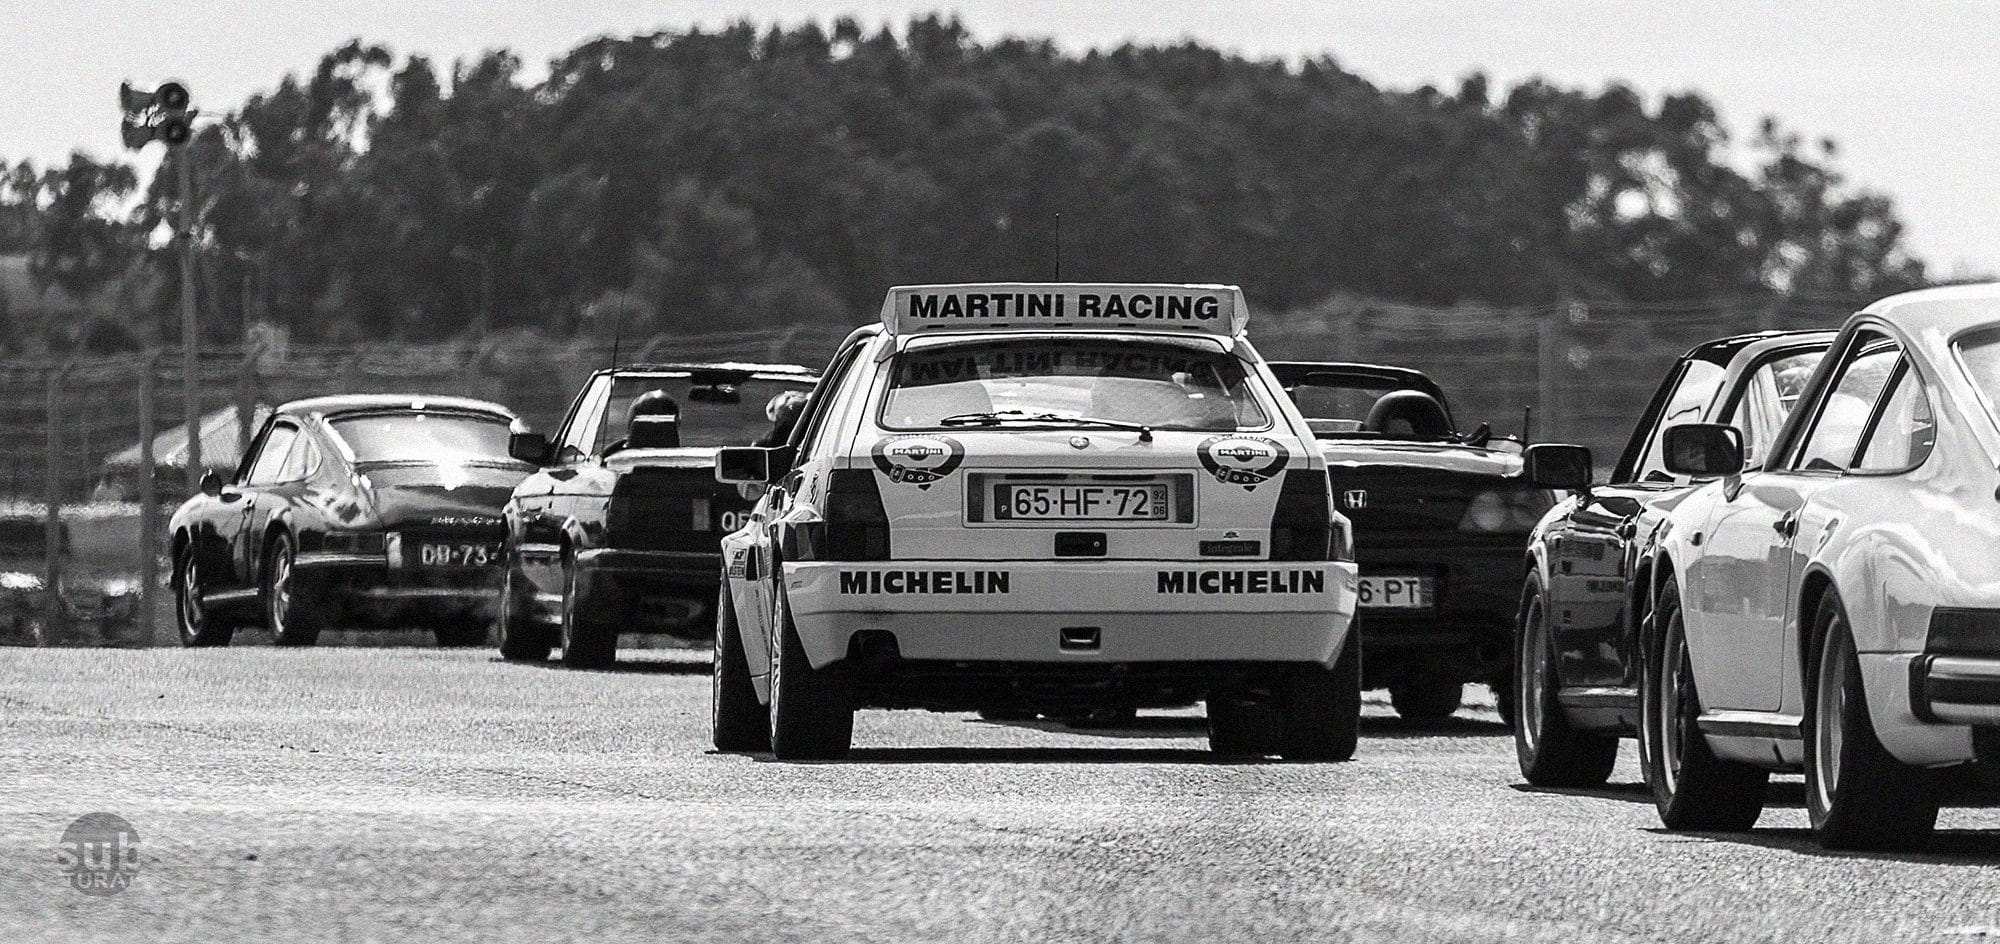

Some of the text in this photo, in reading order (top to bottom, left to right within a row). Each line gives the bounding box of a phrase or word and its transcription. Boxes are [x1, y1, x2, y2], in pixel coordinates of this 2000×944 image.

[909, 293, 1219, 320] MARTINI RACING
[1153, 490, 1165, 501] 92
[1001, 504, 1008, 513] P
[1153, 505, 1165, 515] 06
[840, 571, 1010, 594] MICHELIN
[1157, 570, 1324, 594] MICHELIN
